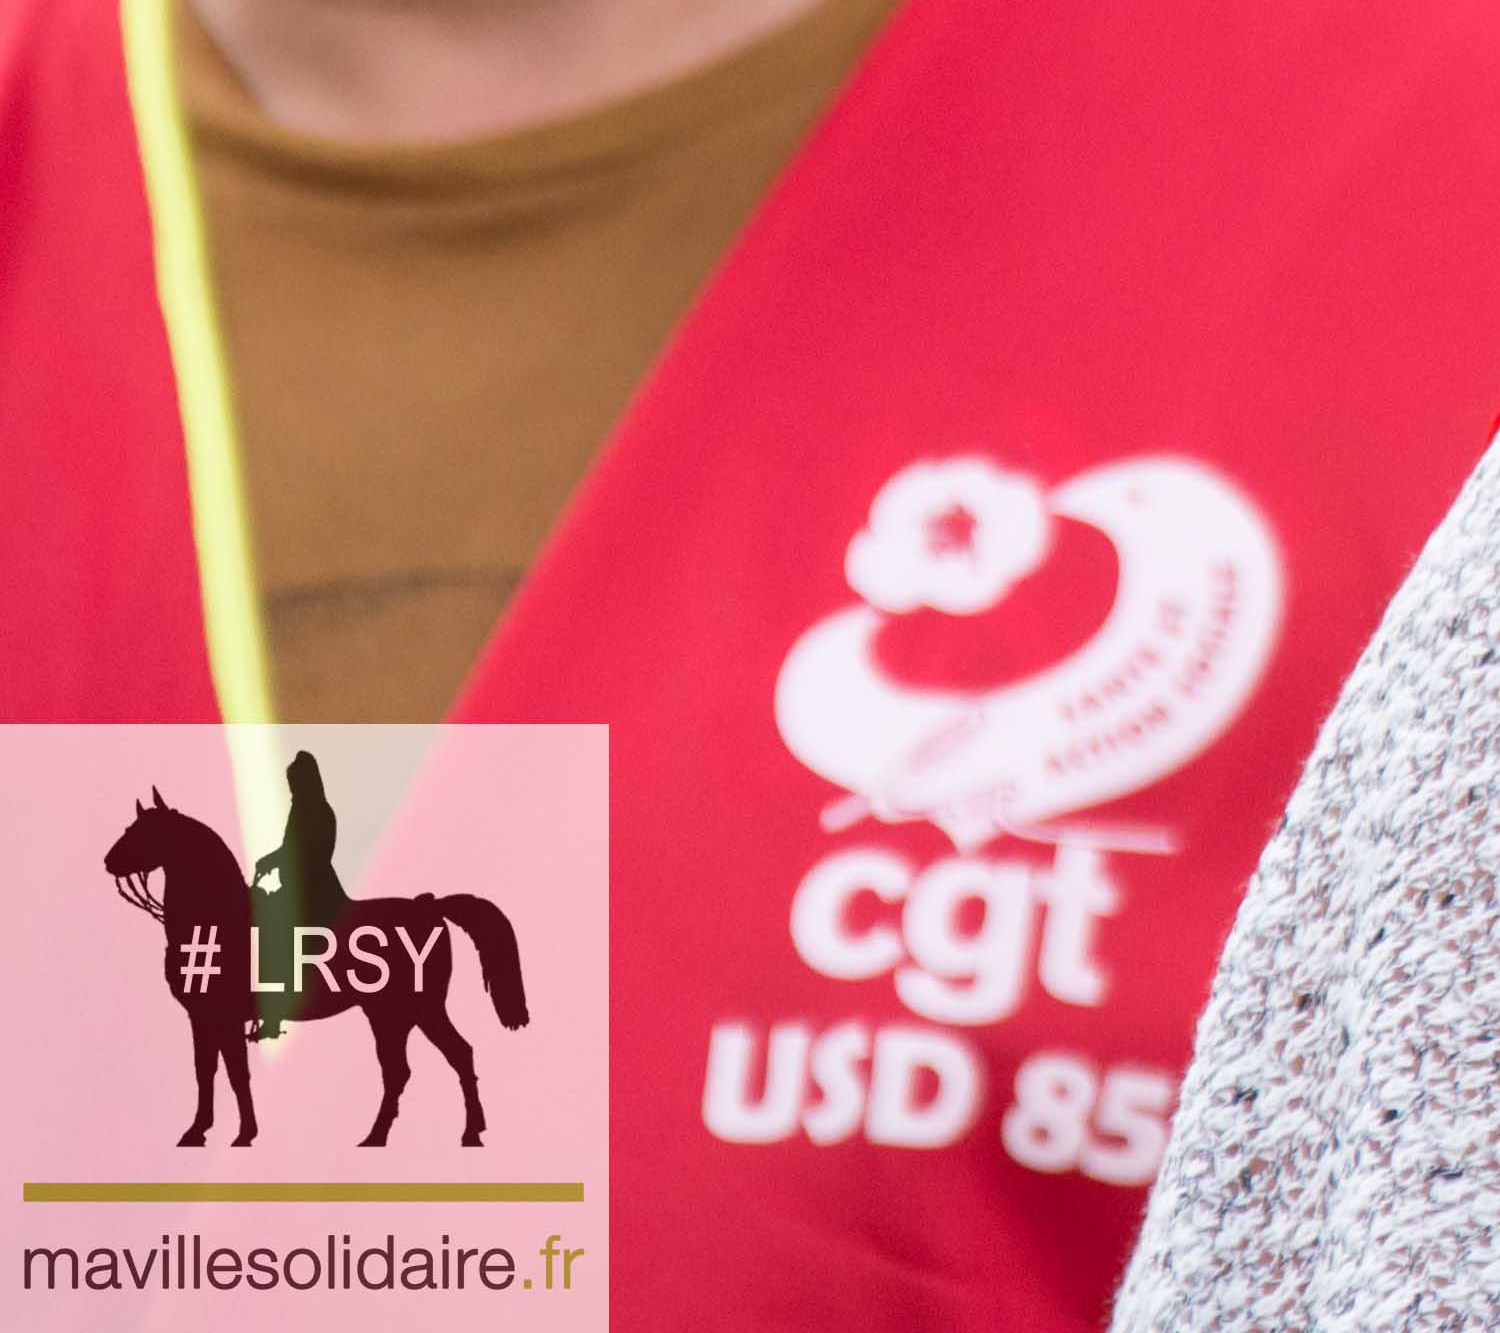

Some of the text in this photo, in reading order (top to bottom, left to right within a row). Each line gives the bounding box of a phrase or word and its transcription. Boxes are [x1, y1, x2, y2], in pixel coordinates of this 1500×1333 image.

[790, 835, 1120, 1025] cgt
[702, 1020, 1174, 1185] USD 85
